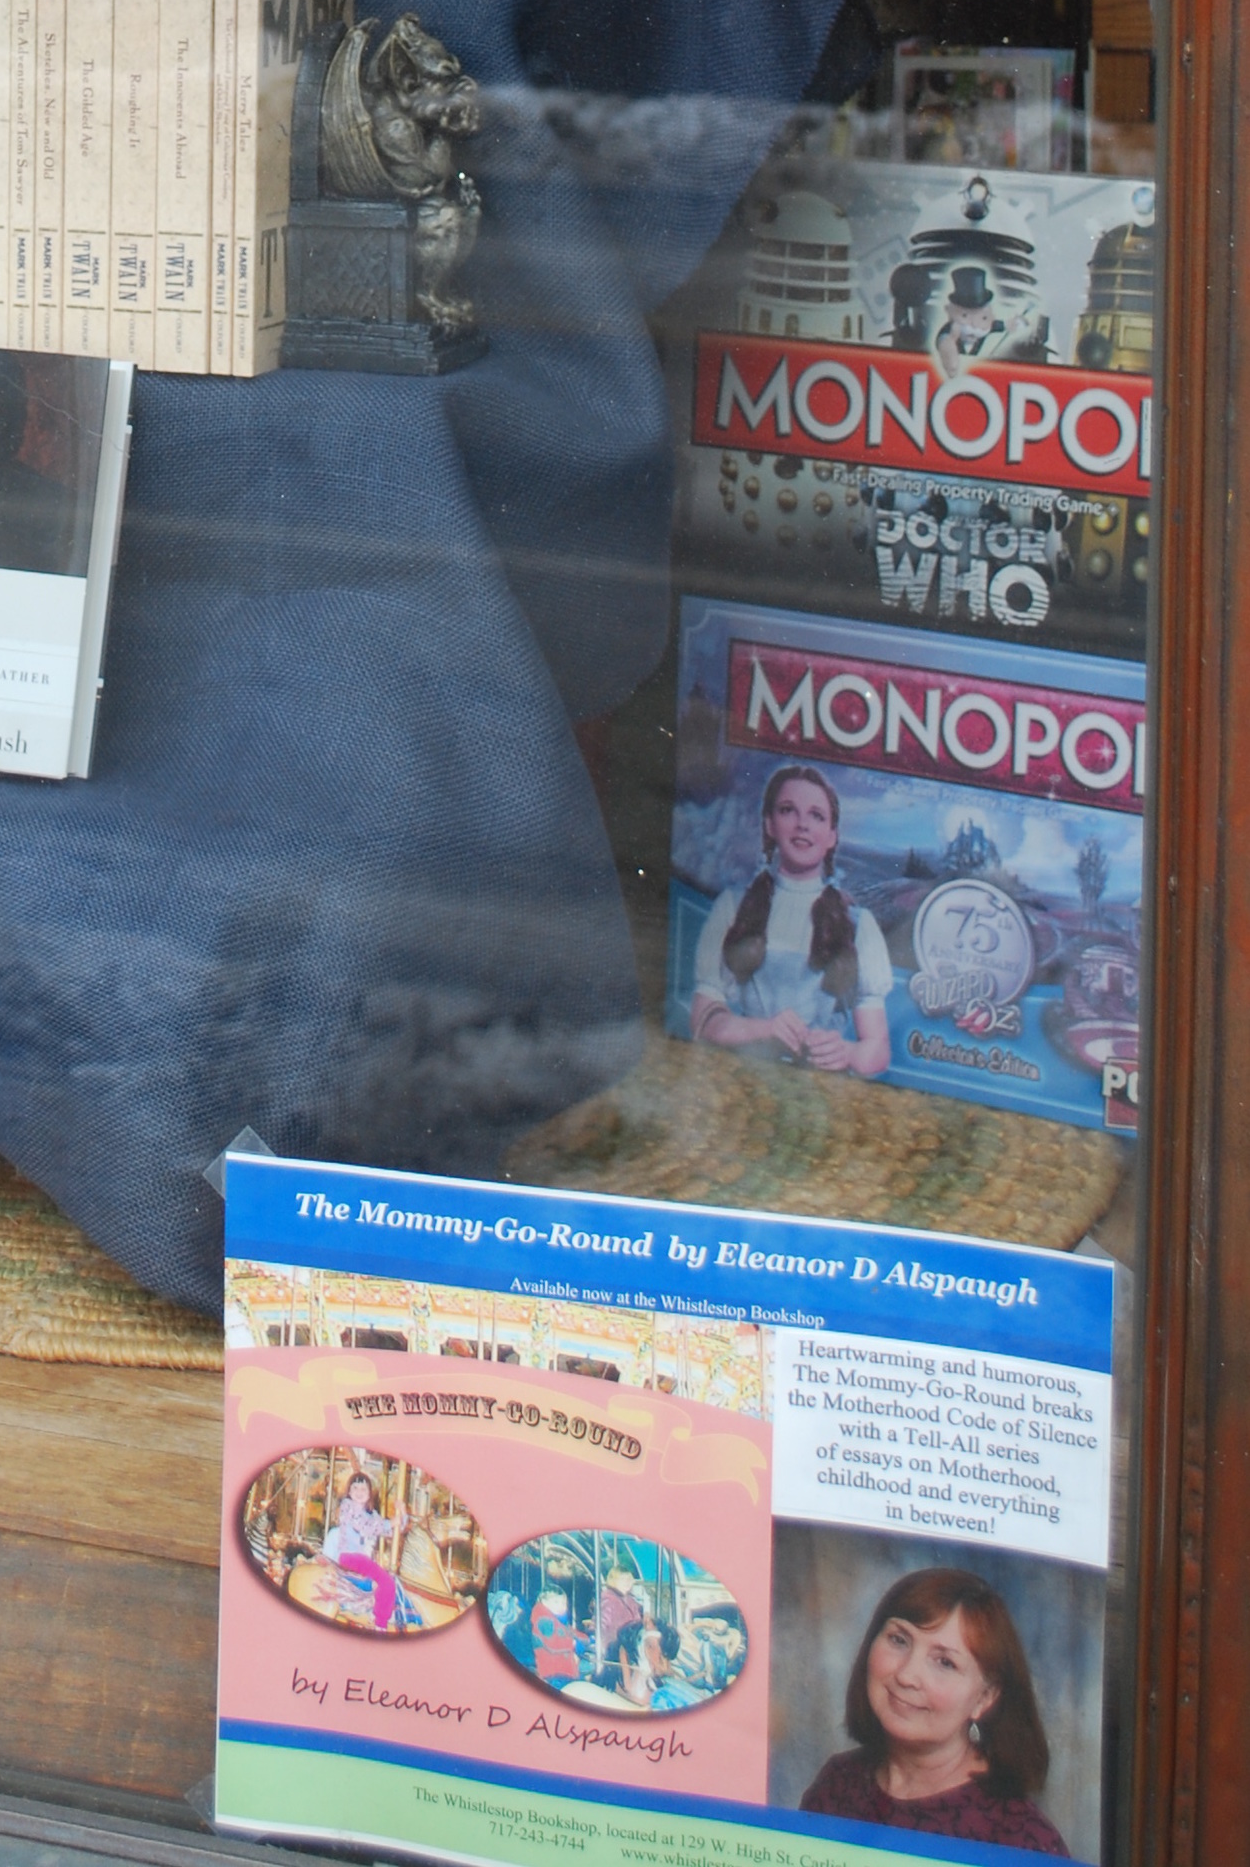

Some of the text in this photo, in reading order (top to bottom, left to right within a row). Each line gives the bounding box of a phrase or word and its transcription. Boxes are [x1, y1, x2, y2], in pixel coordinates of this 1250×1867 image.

[128, 73, 142, 134] Roughing
[175, 38, 190, 180] The Innocents Abroad
[118, 243, 138, 302] TWAIN
[138, 259, 147, 289] MARK
[164, 242, 185, 302] TWAIN
[186, 258, 195, 288] MARK
[925, 479, 995, 505] Property
[997, 487, 1054, 510] Trading
[1056, 495, 1103, 515] Game
[875, 508, 1047, 564] DOCTOR
[875, 545, 1050, 627] WHO
[295, 1192, 1040, 1306] The Mommy-Go-Round by Eleanor D Alspaugh
[509, 1276, 825, 1330] Available now at the Whistlestop Bookshop
[792, 1363, 1094, 1423] The Mommy-Go-Round breaks
[798, 1339, 1083, 1398] Heartwarming and humorous,
[345, 1390, 643, 1461] THE MOMMY-GO-ROUND
[788, 1389, 1098, 1450] the Motherhood Code of Silence
[838, 1421, 1040, 1465] with a Tell-All series
[815, 1442, 1062, 1498] of essays on Motherhood,
[816, 1468, 1061, 1524] childhood and everything
[885, 1501, 997, 1535] in between!
[291, 1667, 694, 1764] by Eleanor D Alspaugh
[413, 1785, 440, 1805] The
[444, 1791, 525, 1823] Whistlestop
[528, 1809, 602, 1838] Bookshop,
[606, 1822, 658, 1845] located
[661, 1831, 675, 1847] at
[680, 1832, 707, 1850] 129
[710, 1837, 731, 1856] W.
[736, 1842, 773, 1864] High
[775, 1847, 796, 1867] St.
[488, 1820, 587, 1853] 717-243-4744
